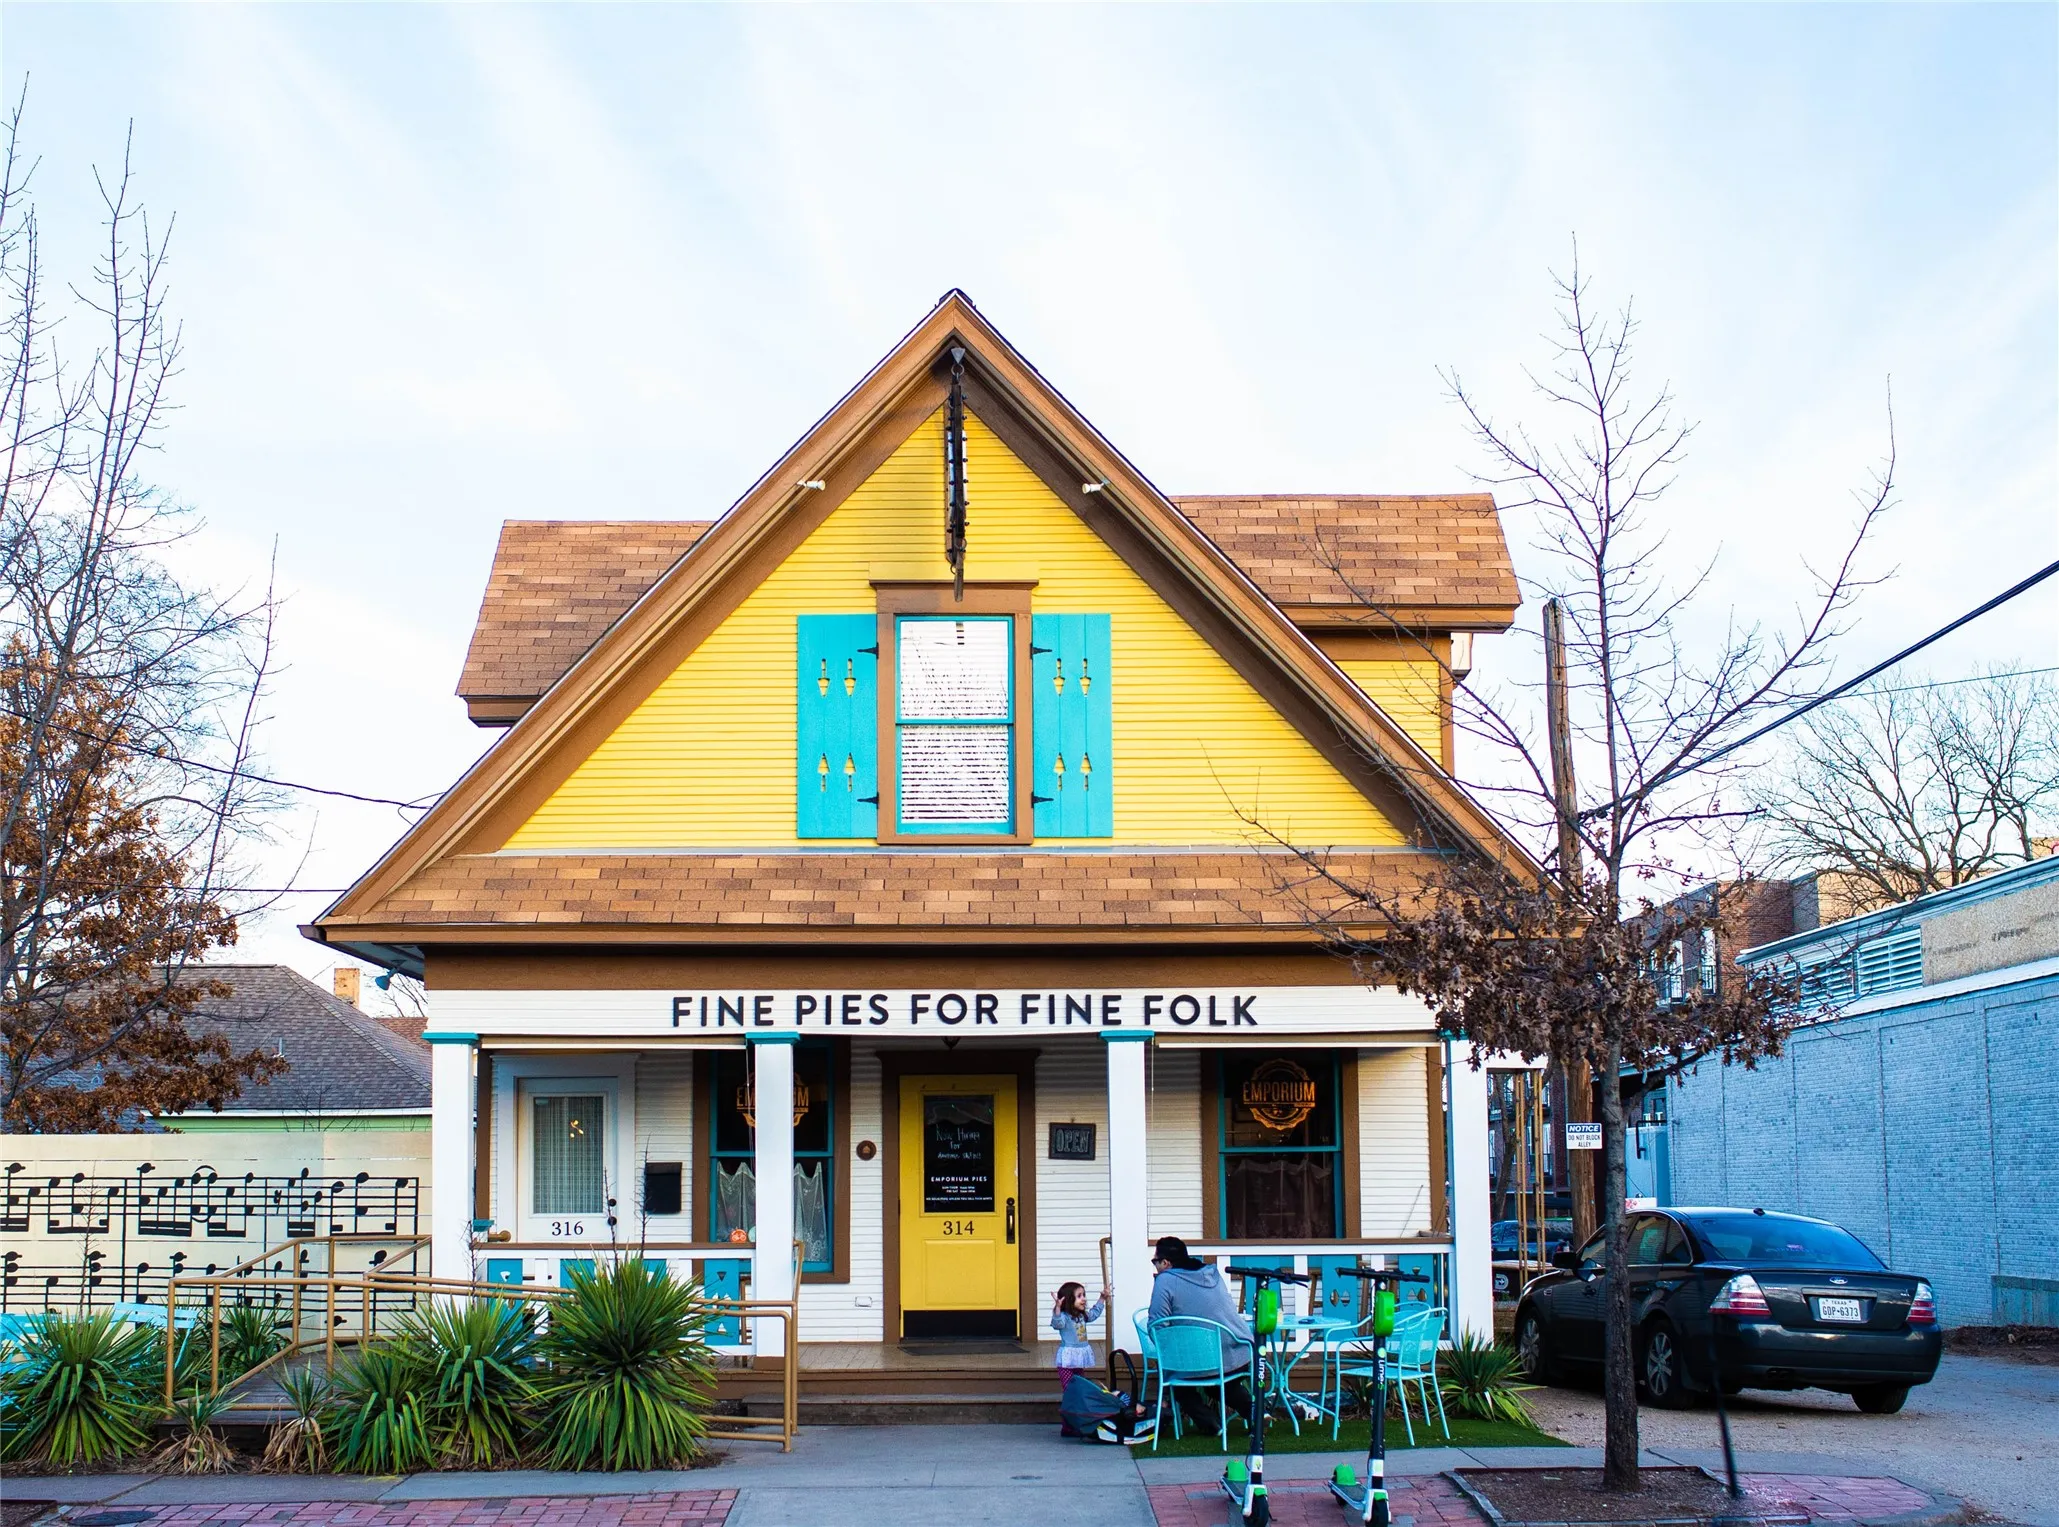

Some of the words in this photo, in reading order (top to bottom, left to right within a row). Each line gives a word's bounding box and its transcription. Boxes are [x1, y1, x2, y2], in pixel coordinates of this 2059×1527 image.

[673, 995, 775, 1027] FINE
[796, 993, 889, 1026] PIES
[911, 993, 999, 1025] FOR
[1021, 993, 1122, 1026] FINE
[1144, 994, 1258, 1026] FOLK
[1243, 1081, 1315, 1101] EMPORIUM
[1055, 1129, 1090, 1153] OPEN
[551, 1221, 584, 1236] 316
[943, 1221, 974, 1235] 314
